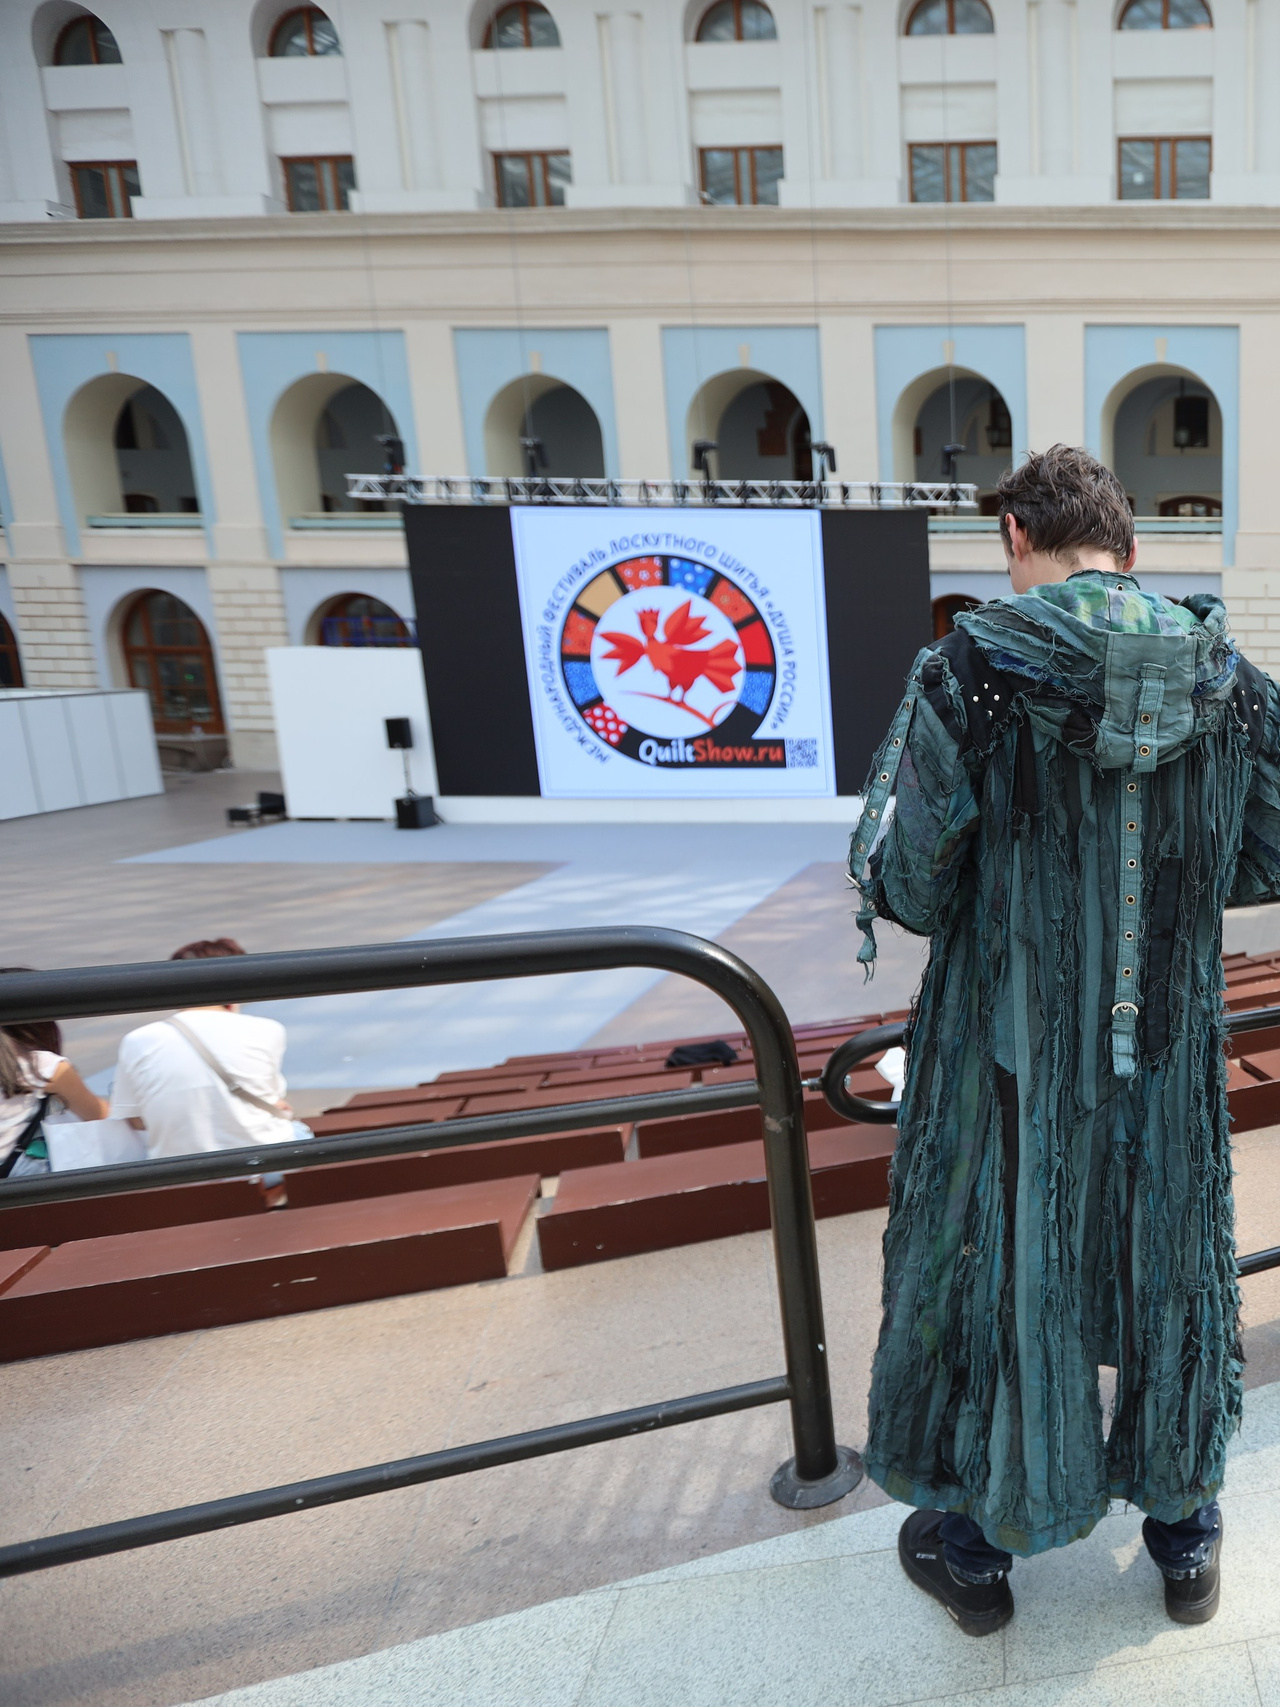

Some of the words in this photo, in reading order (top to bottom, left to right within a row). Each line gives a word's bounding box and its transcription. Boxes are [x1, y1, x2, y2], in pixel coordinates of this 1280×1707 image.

[609, 532, 717, 557] ЛОСКУТНОГО
[542, 547, 606, 623] ФЕСТИВАЛЬ
[718, 551, 770, 598] ШИТЬЯ
[536, 624, 609, 763] МЕЖДУНАРОДНЫЙ
[638, 737, 784, 766] QuiltShow.ru
